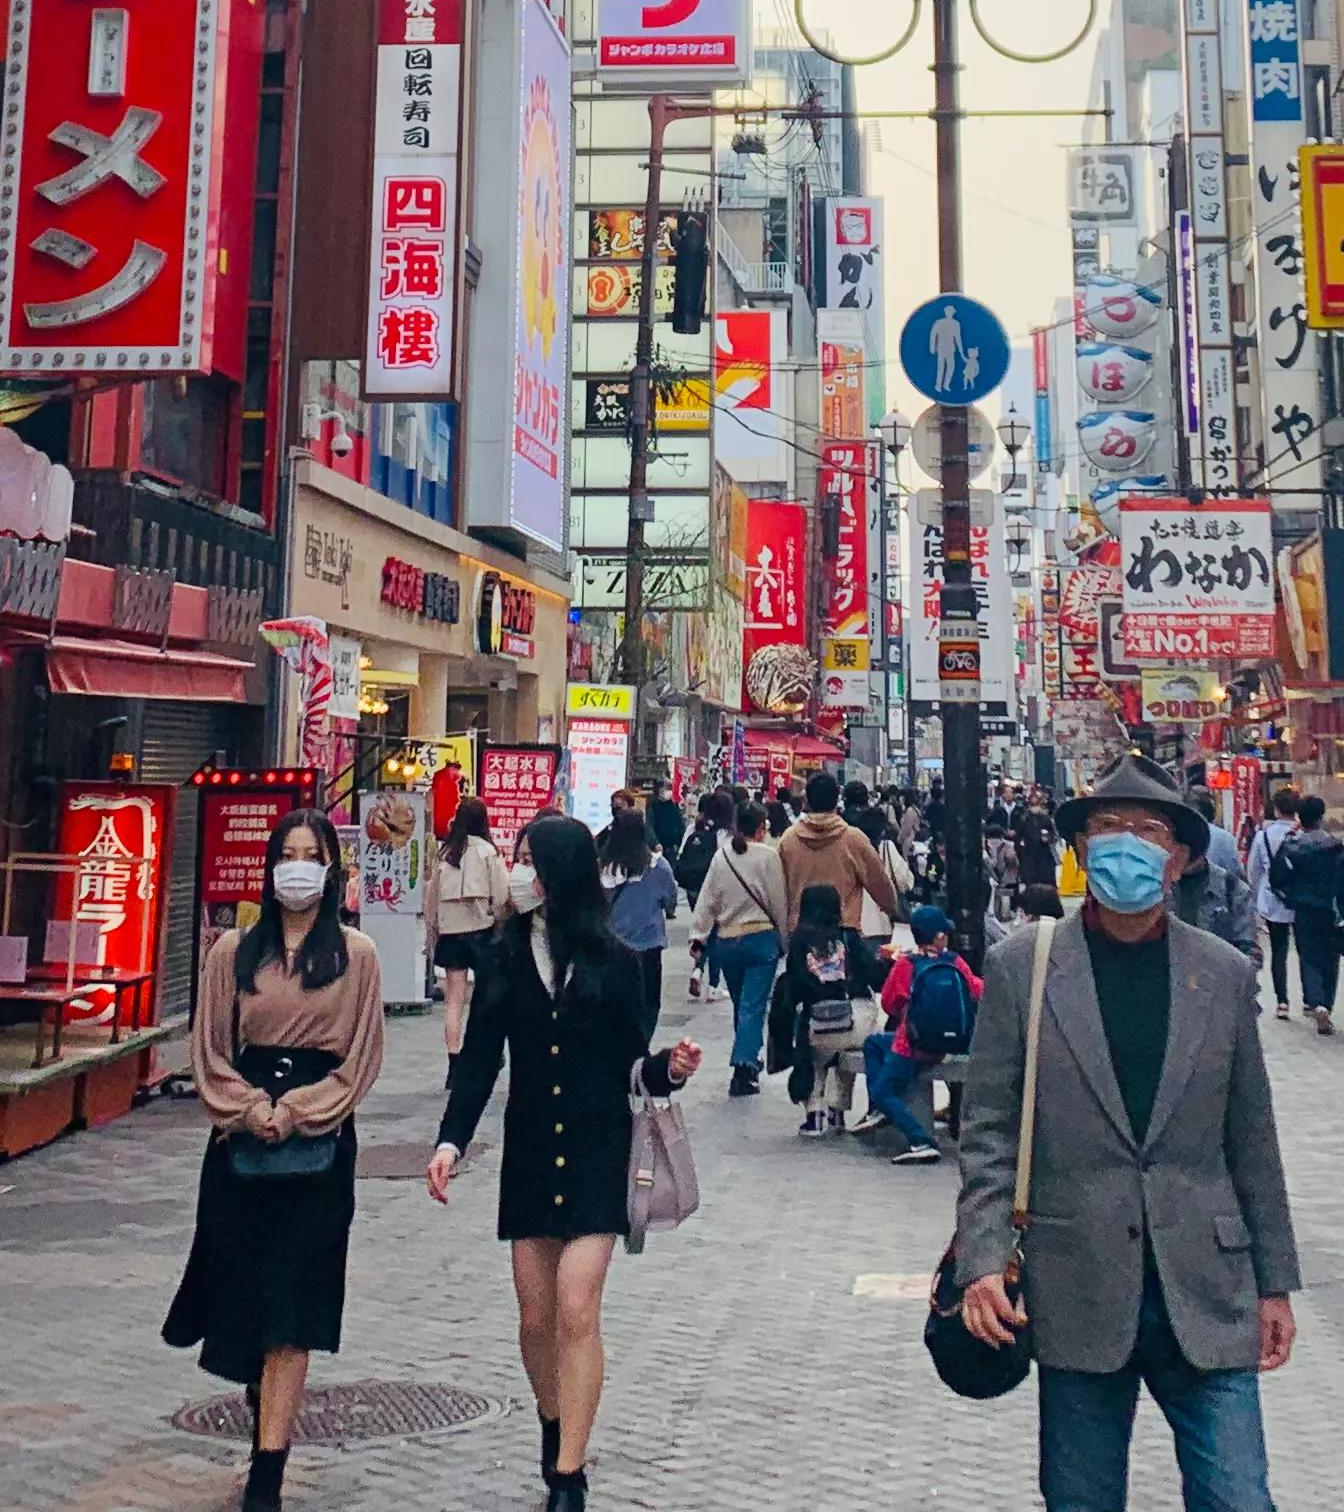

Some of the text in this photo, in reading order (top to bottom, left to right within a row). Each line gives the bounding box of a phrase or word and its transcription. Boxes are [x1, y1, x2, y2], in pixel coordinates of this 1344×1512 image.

[1249, 0, 1300, 101] 焼肉
[402, 48, 434, 150] 回転寿司
[377, 175, 446, 370] 四海樓
[606, 570, 690, 595] ZZA
[1125, 535, 1270, 594] わなか
[1153, 628, 1209, 654] No.1
[489, 755, 549, 772] 大起水産
